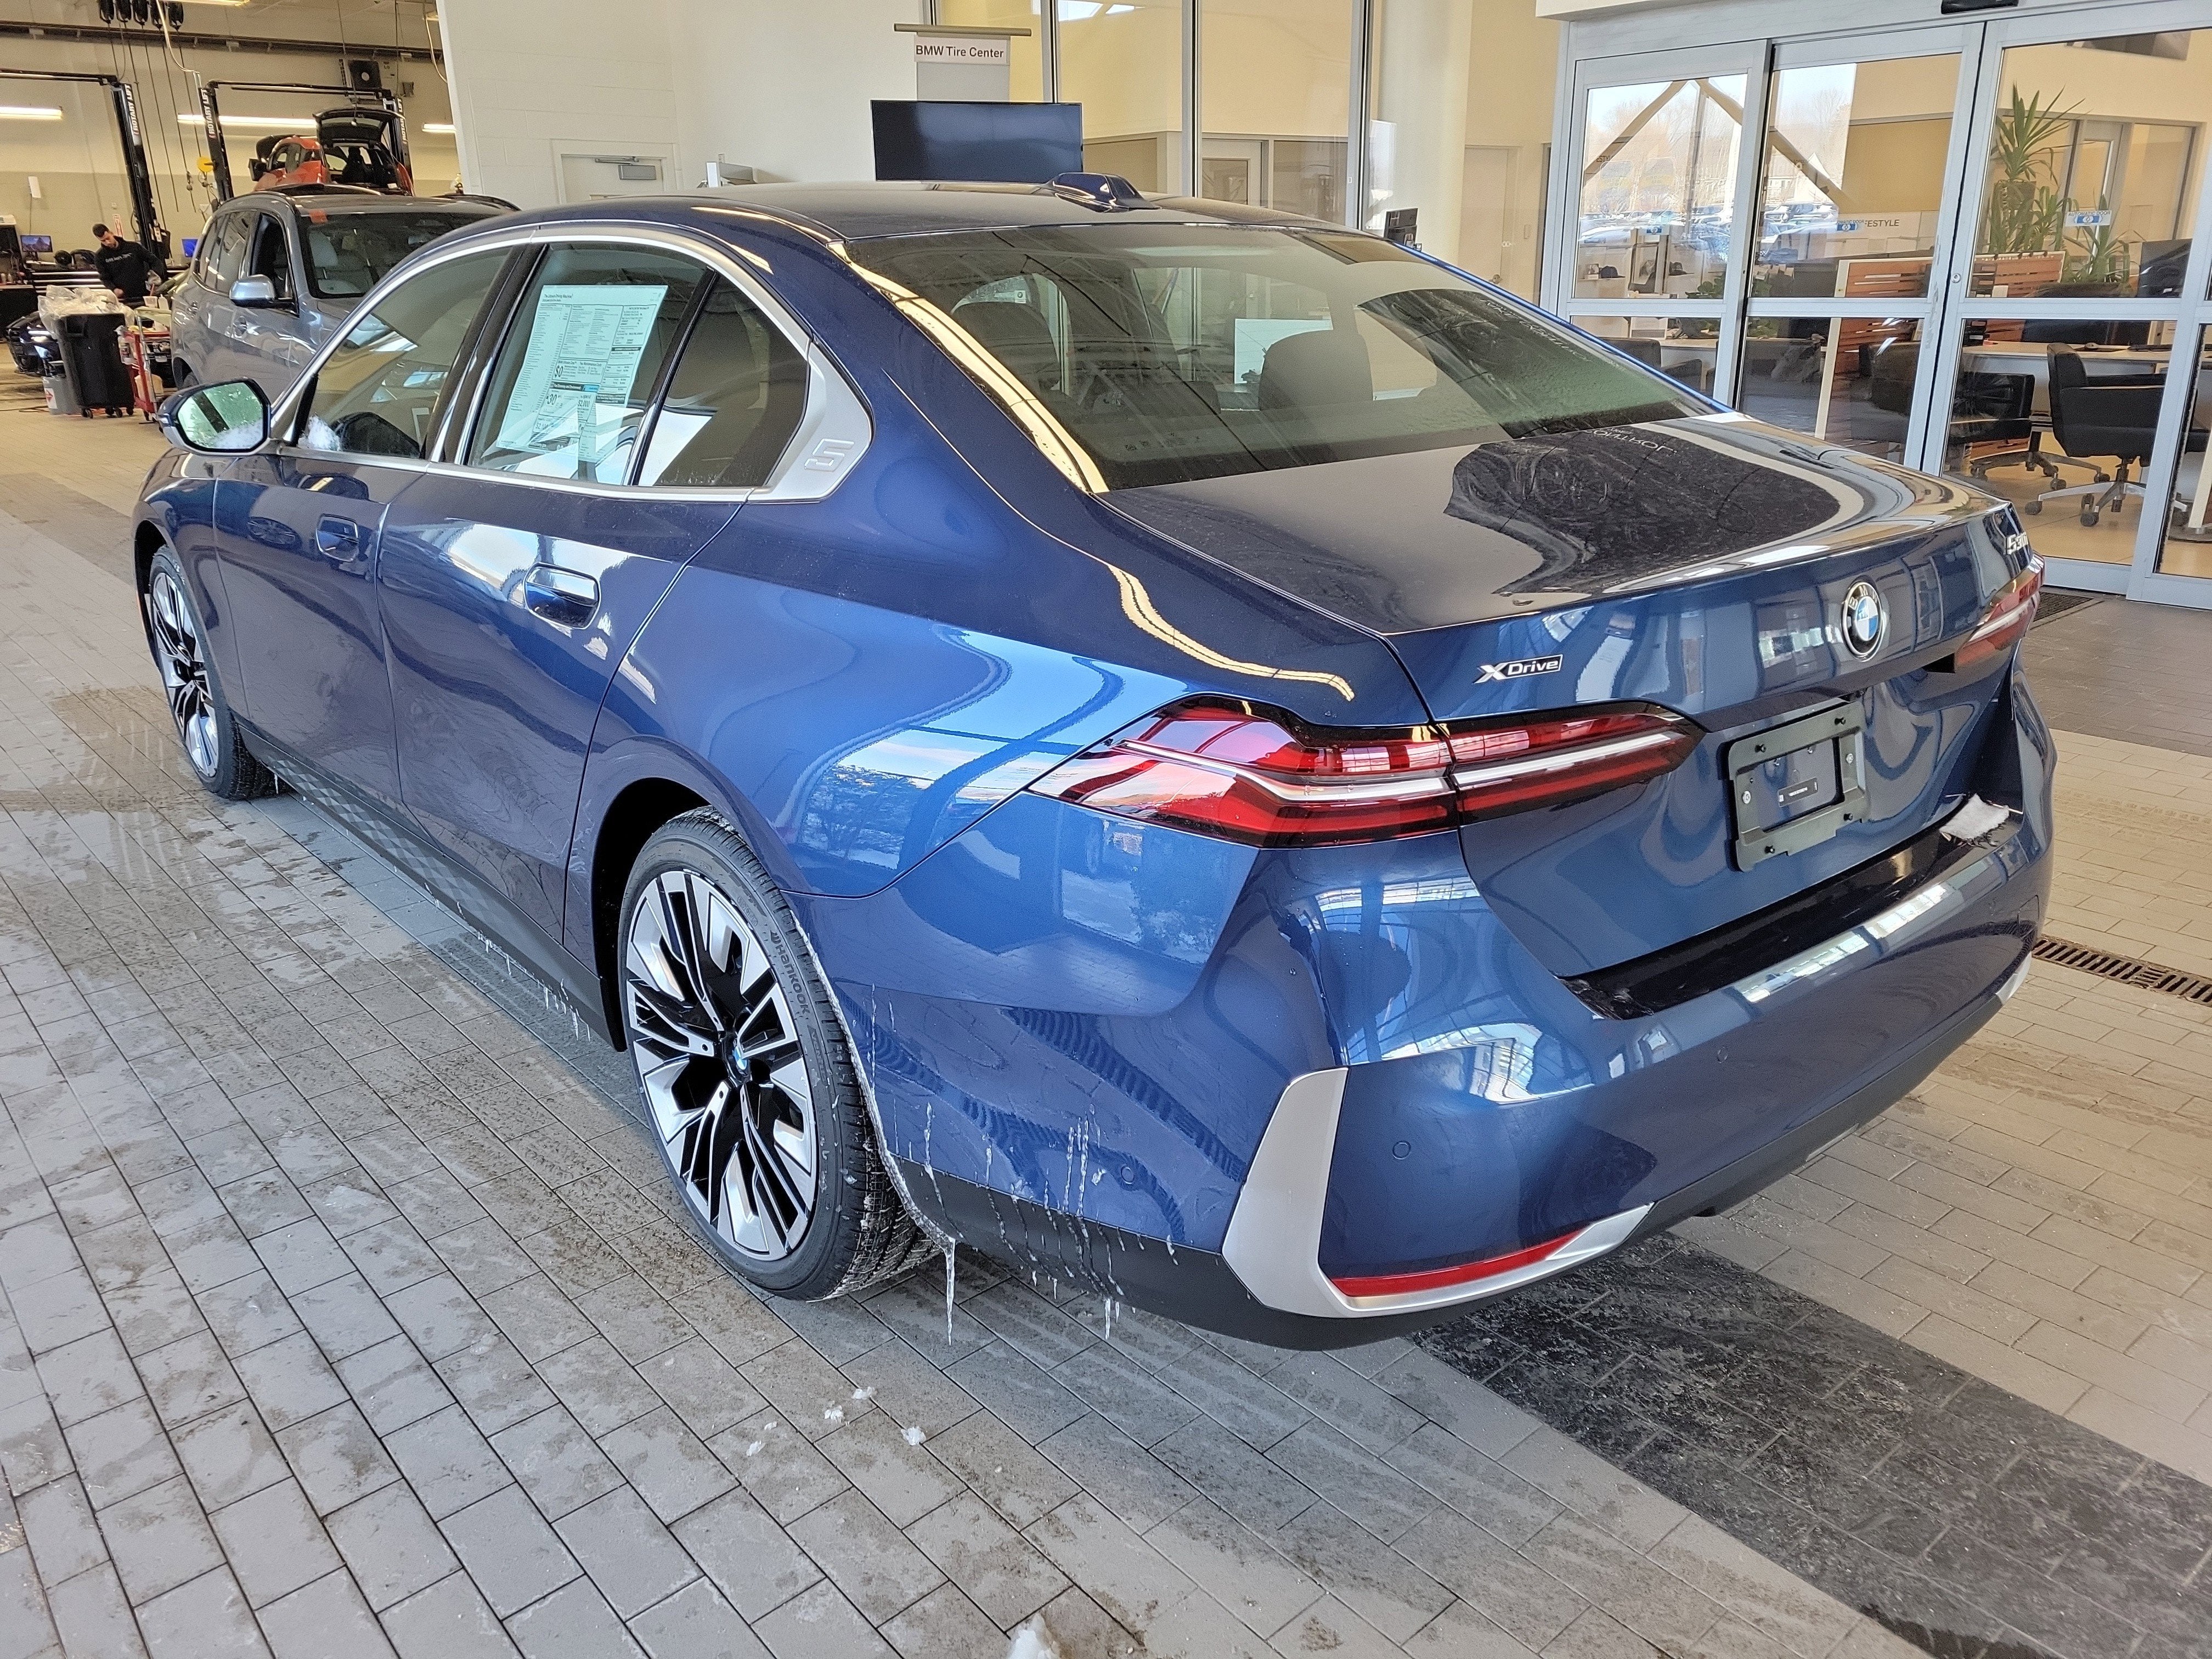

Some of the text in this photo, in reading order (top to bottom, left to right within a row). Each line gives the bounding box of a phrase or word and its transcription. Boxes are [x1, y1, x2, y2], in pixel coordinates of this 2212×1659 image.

[916, 45, 1004, 58] BMW Tire Center
[124, 83, 139, 132] ROTARY LIFT
[200, 88, 216, 134] ROTARY LIFT
[804, 438, 855, 472] 5
[1848, 584, 1878, 611] BMW
